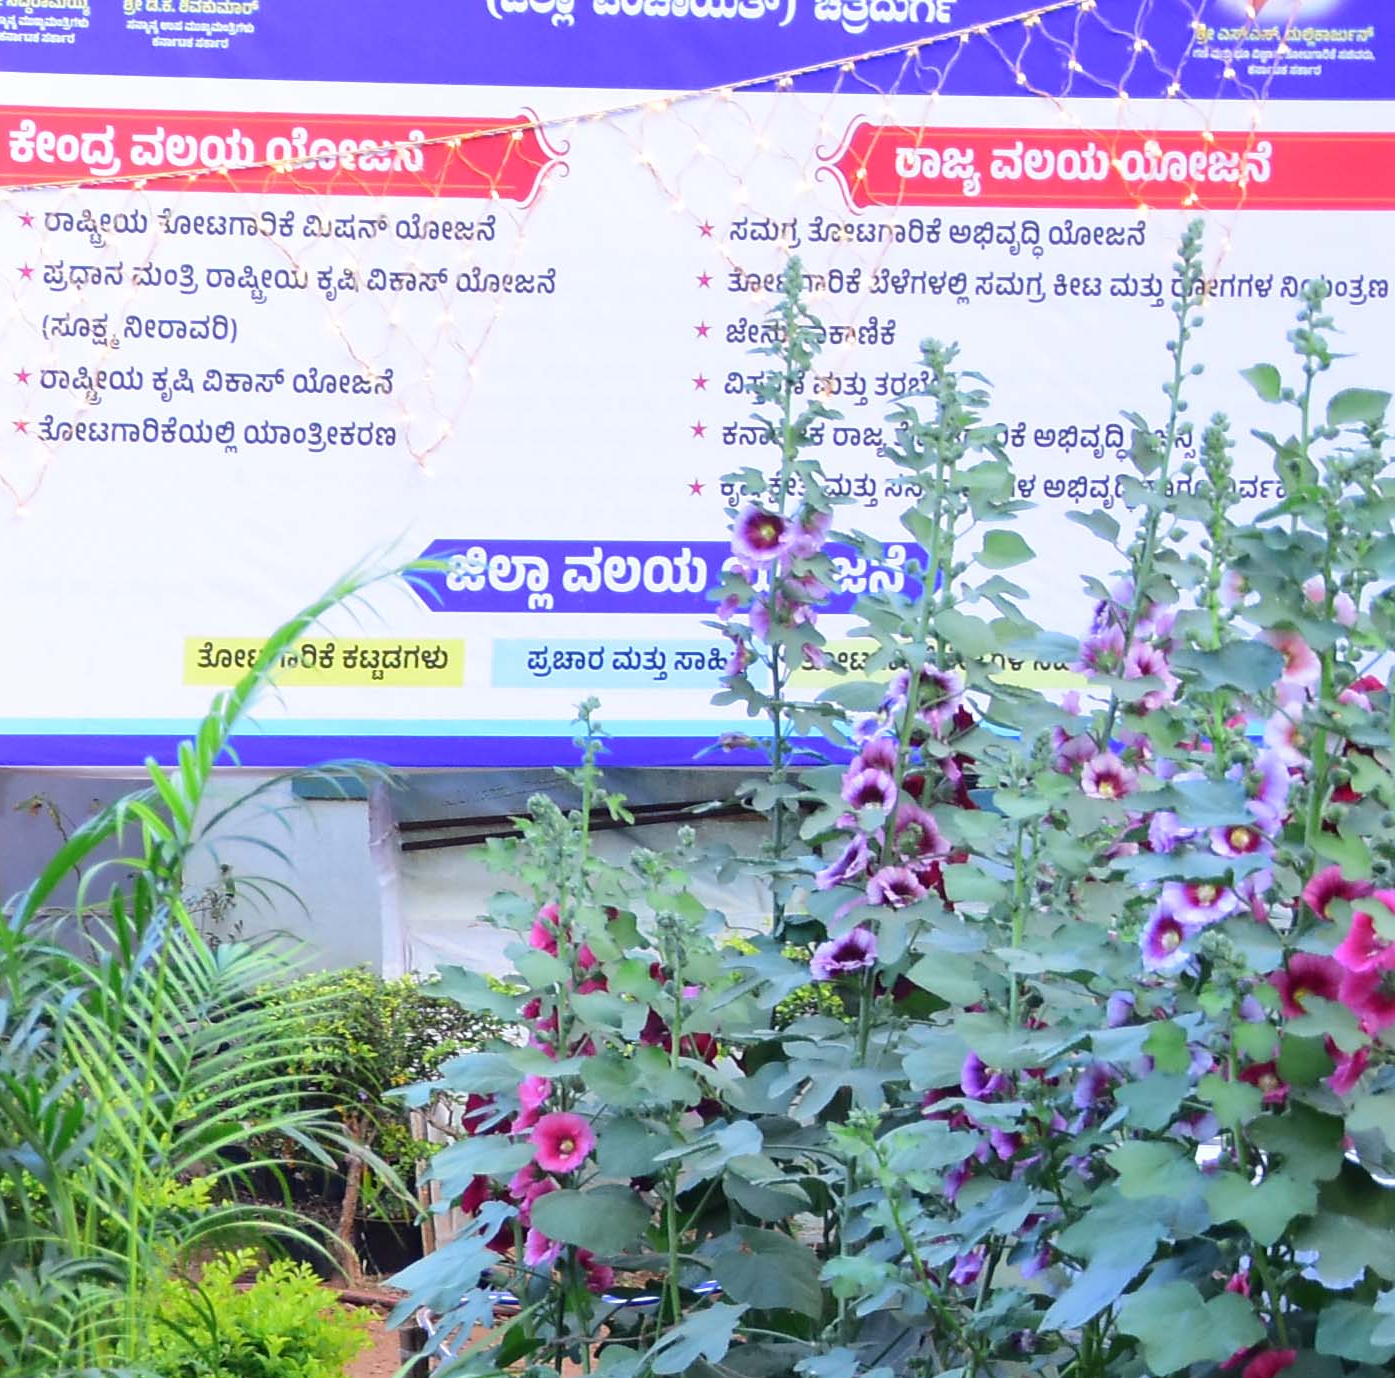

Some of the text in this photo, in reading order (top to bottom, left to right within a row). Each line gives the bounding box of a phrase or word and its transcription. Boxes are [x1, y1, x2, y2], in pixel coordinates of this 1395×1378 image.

[9, 118, 122, 176] ಕೇಂದ್ರ
[130, 125, 254, 173] ವಲಯ
[895, 141, 983, 197] ರಾಜ್ಯ
[991, 140, 1113, 184] ವಲಯ
[395, 213, 496, 242] ಯೋಜನೆ
[729, 216, 801, 249] ಸಮಗ್ರ
[1049, 219, 1147, 247] ಯೋಜನೆ
[43, 262, 123, 292] ಪ್ರಧಾನ
[456, 265, 557, 295] ಯೋಜನೆ
[975, 271, 1047, 304] ಸಮಗ್ರ
[1053, 273, 1101, 297] ಕೀಟ
[1110, 274, 1165, 307] ಮತ್ತು
[40, 364, 143, 405] ರಾಷ್ಟ್ರೀಯ
[152, 367, 194, 402] ಕೃಷಿ
[203, 366, 285, 394] ವಿಕಾಸ್
[563, 546, 707, 594] ವಲಯ
[527, 645, 668, 681] ಪ್ರಚಾರ ಮತ್ತು
